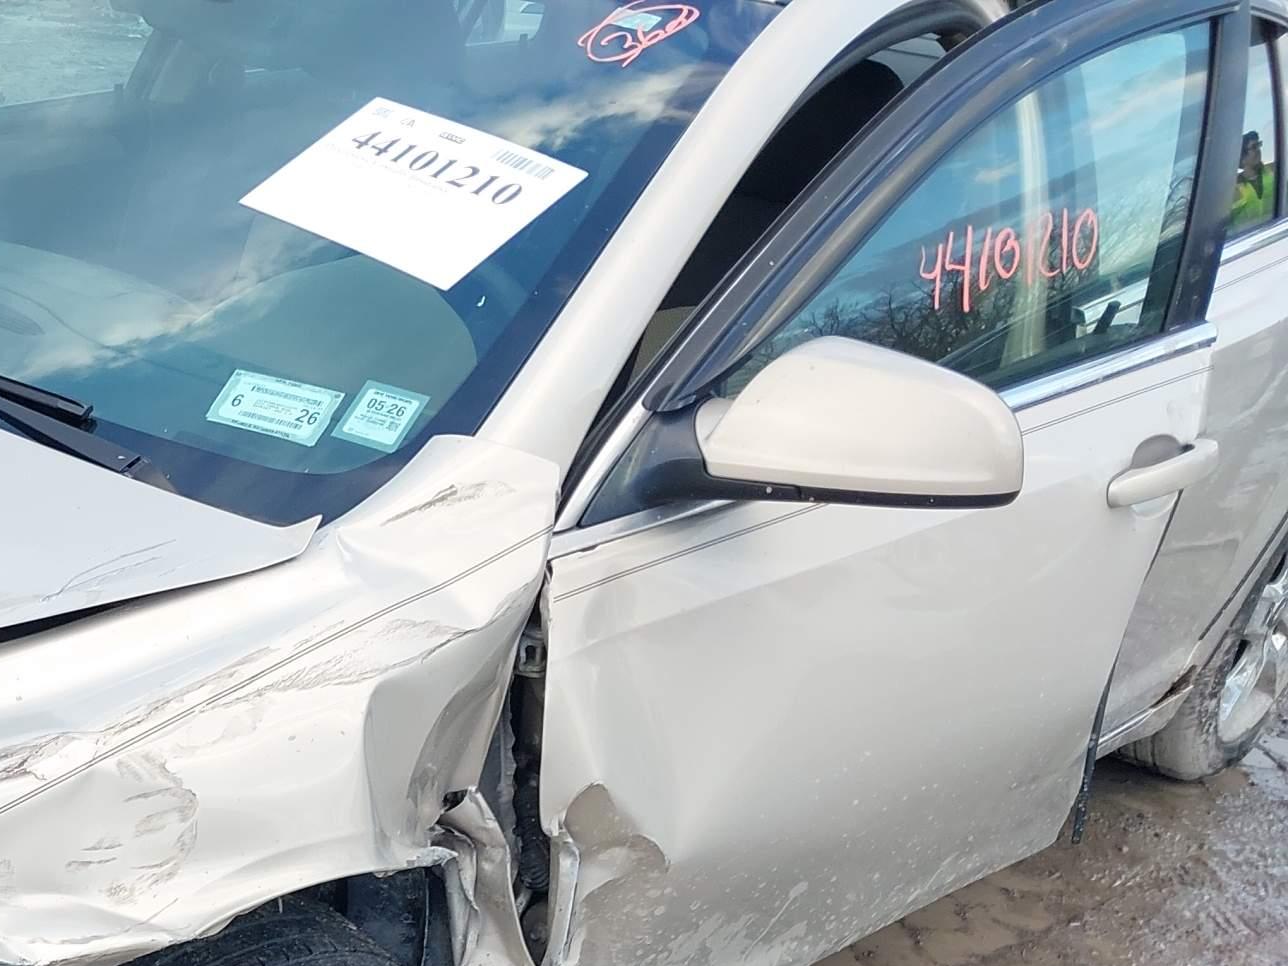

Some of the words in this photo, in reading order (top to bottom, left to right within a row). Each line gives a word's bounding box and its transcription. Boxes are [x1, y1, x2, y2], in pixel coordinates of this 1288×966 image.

[351, 130, 523, 205] 44101210
[919, 207, 1098, 313] 44101210
[231, 393, 244, 407] 6
[295, 408, 320, 426] 26
